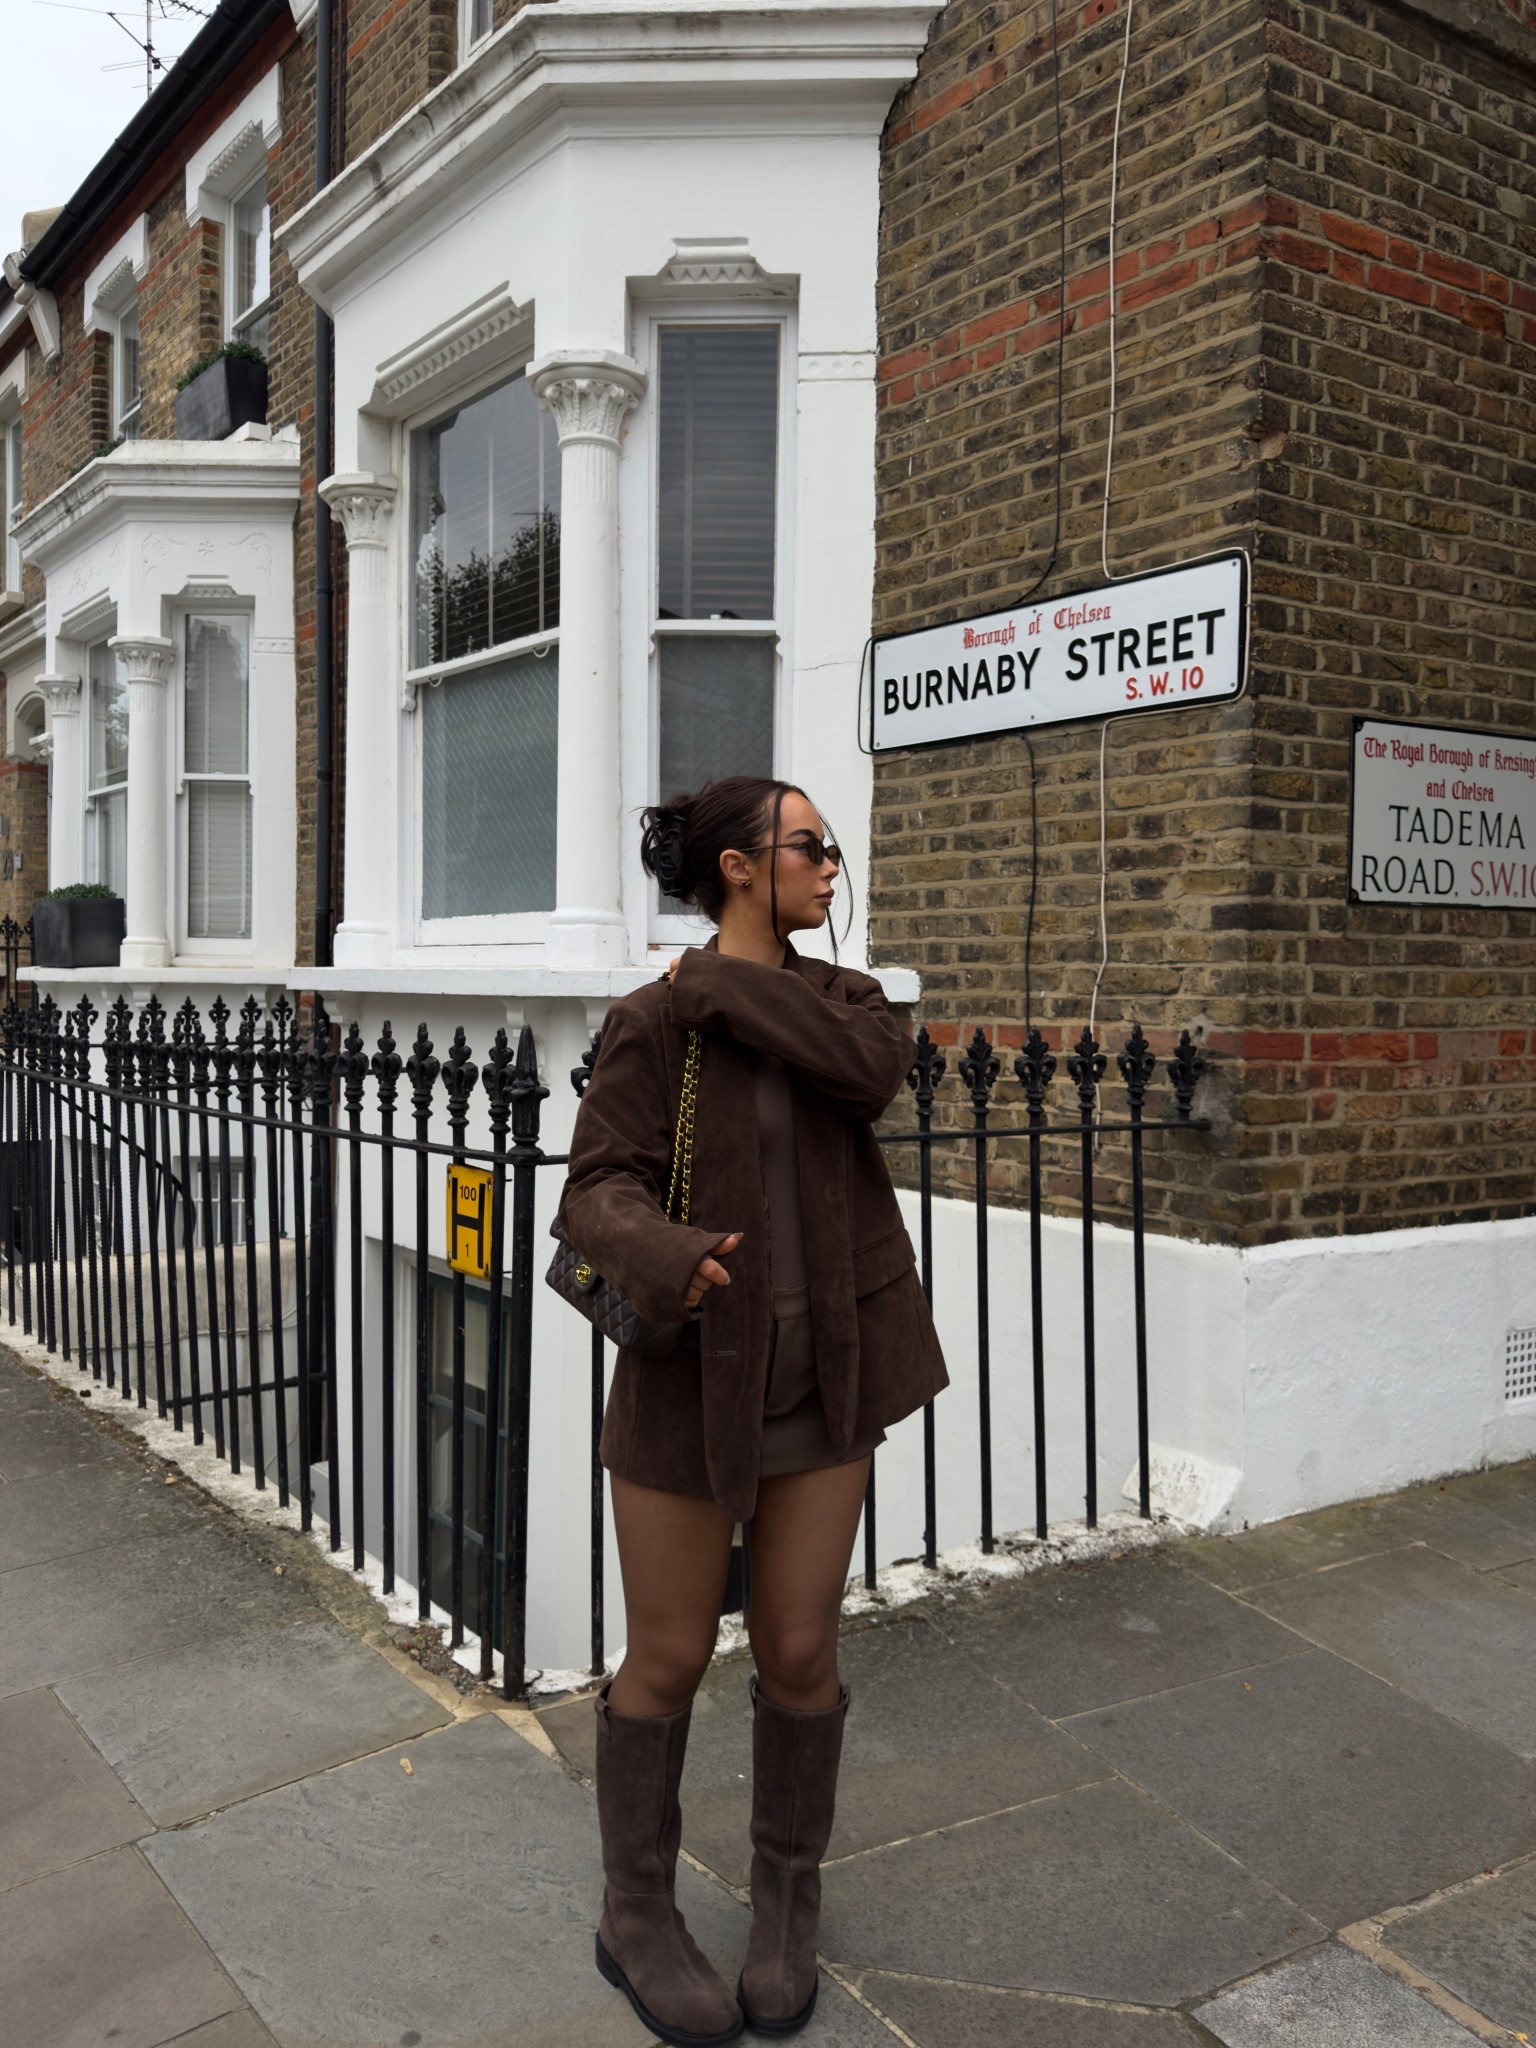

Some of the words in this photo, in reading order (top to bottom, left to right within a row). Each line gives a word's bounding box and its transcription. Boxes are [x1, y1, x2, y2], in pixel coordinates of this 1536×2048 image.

[963, 619, 1016, 649] Borough
[1028, 612, 1043, 635] of
[1053, 602, 1112, 630] Chelsea
[884, 647, 1041, 715] BURNABY
[1065, 608, 1225, 681] STREET
[1364, 737, 1387, 758] The
[1390, 739, 1424, 767] Royal
[1429, 743, 1473, 772] Borough
[1479, 750, 1491, 769] of
[1495, 749, 1536, 779] Kensing
[1427, 779, 1446, 799] and
[1452, 780, 1494, 802] Chelsea
[1389, 804, 1526, 849] TADEMA
[460, 1185, 477, 1201] 100
[451, 1177, 486, 1270] H
